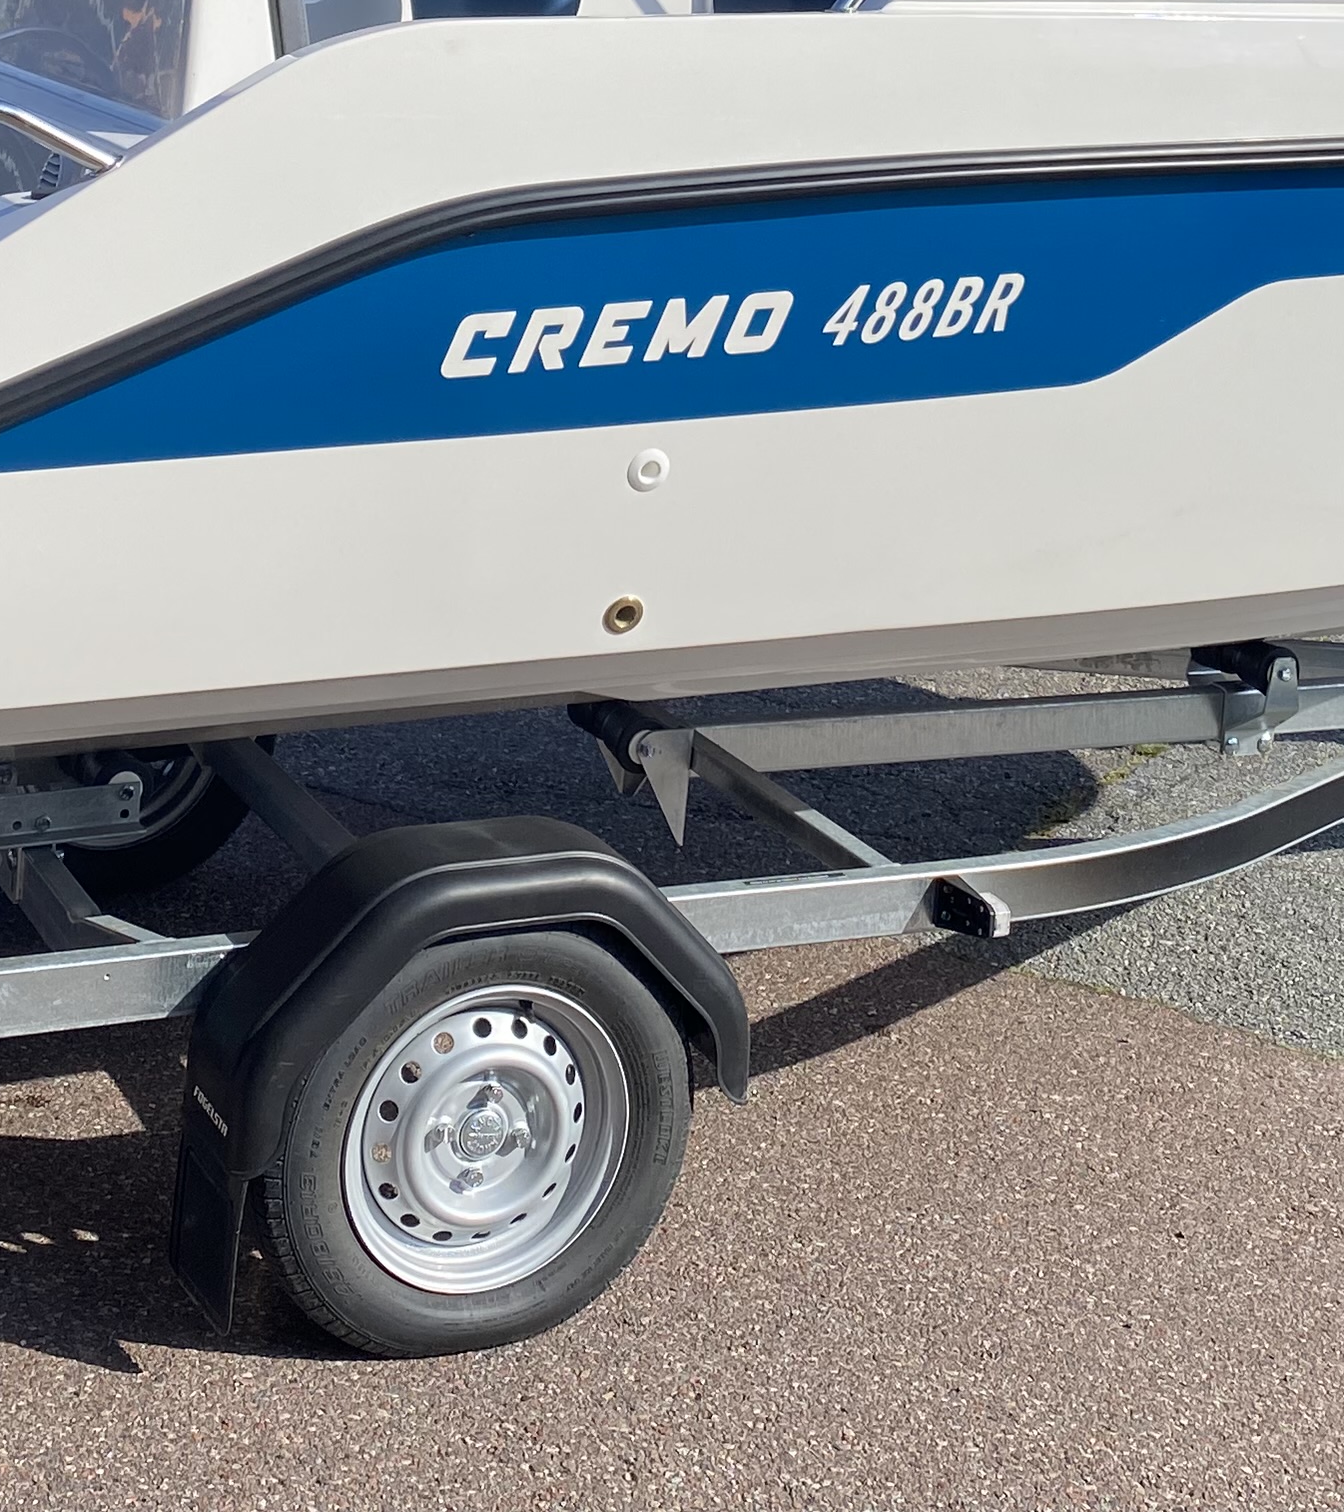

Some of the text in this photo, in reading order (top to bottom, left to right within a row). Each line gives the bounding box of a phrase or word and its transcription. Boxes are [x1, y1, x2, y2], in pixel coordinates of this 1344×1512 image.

[440, 273, 1025, 379] CREMO 488BR
[193, 1085, 228, 1137] FOGELSTA
